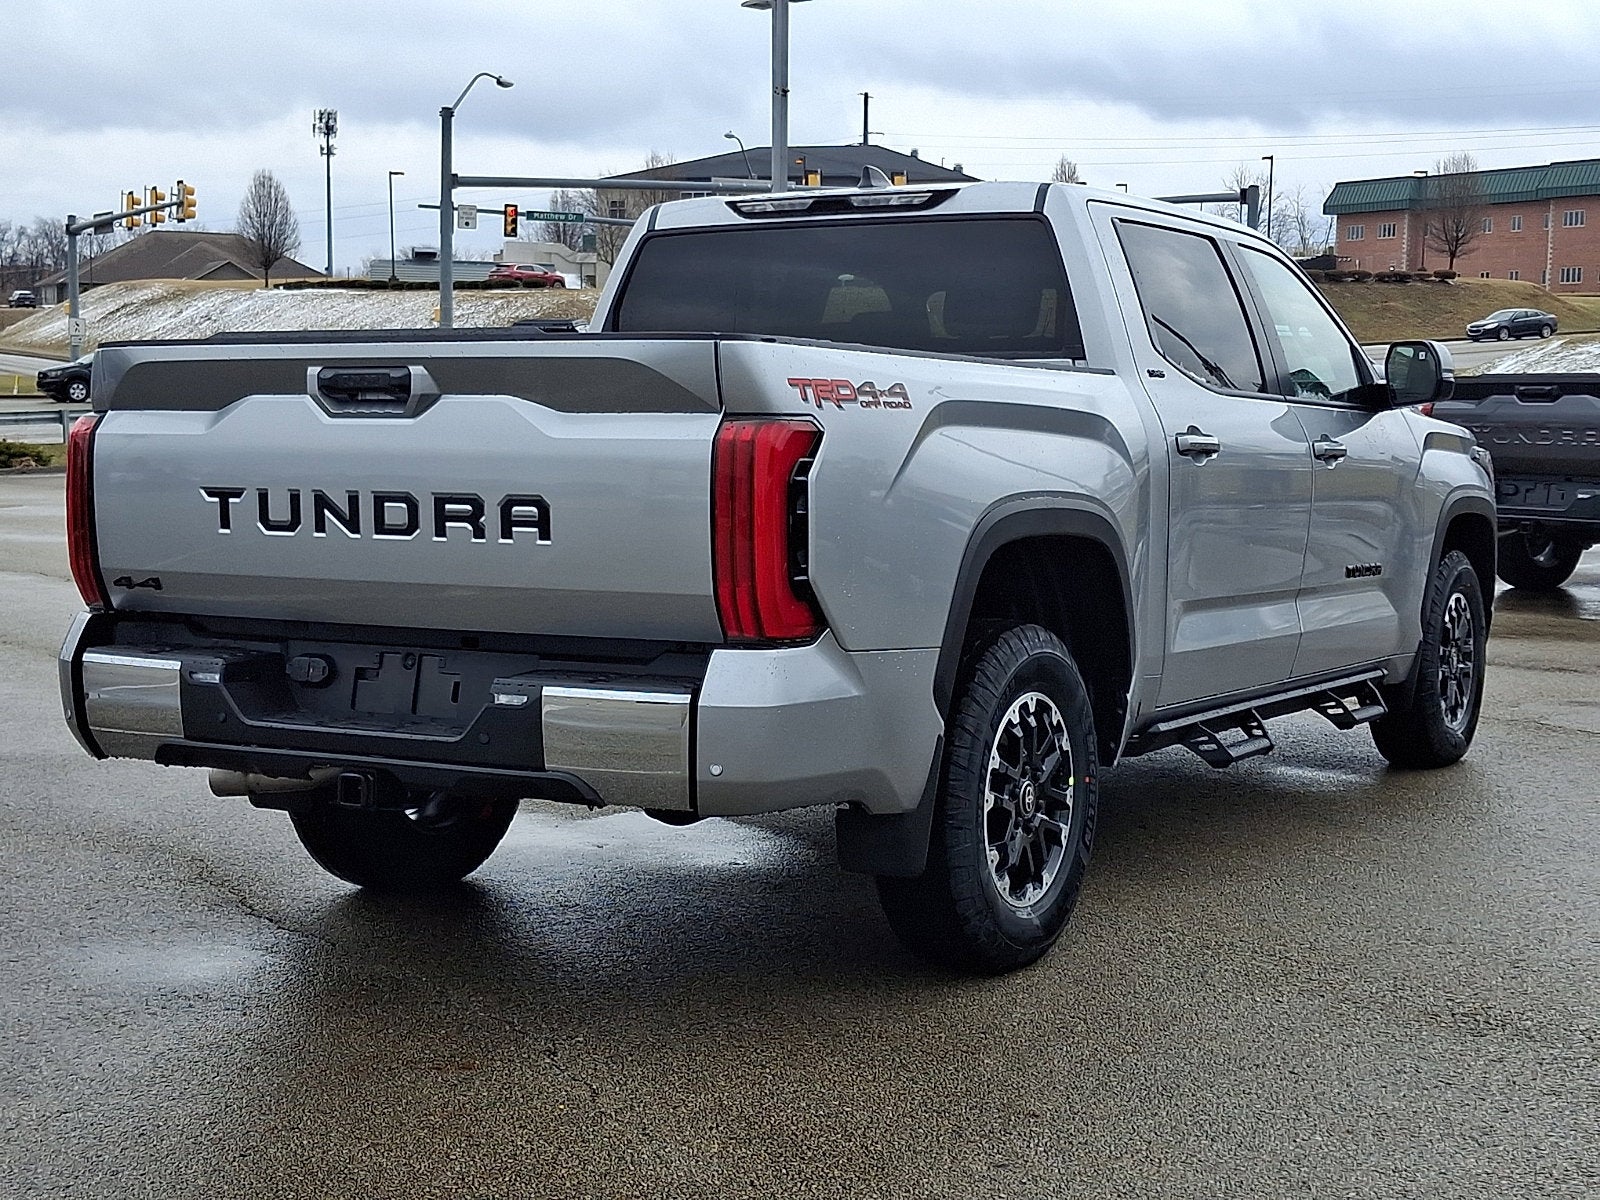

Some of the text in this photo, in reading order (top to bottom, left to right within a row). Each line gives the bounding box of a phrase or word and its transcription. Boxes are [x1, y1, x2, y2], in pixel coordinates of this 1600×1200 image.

[533, 212, 577, 221] Matthew Dr
[787, 378, 858, 411] TRD
[860, 400, 912, 410] OFF ROAD
[199, 486, 552, 545] TUNDRA
[112, 575, 163, 591] 44
